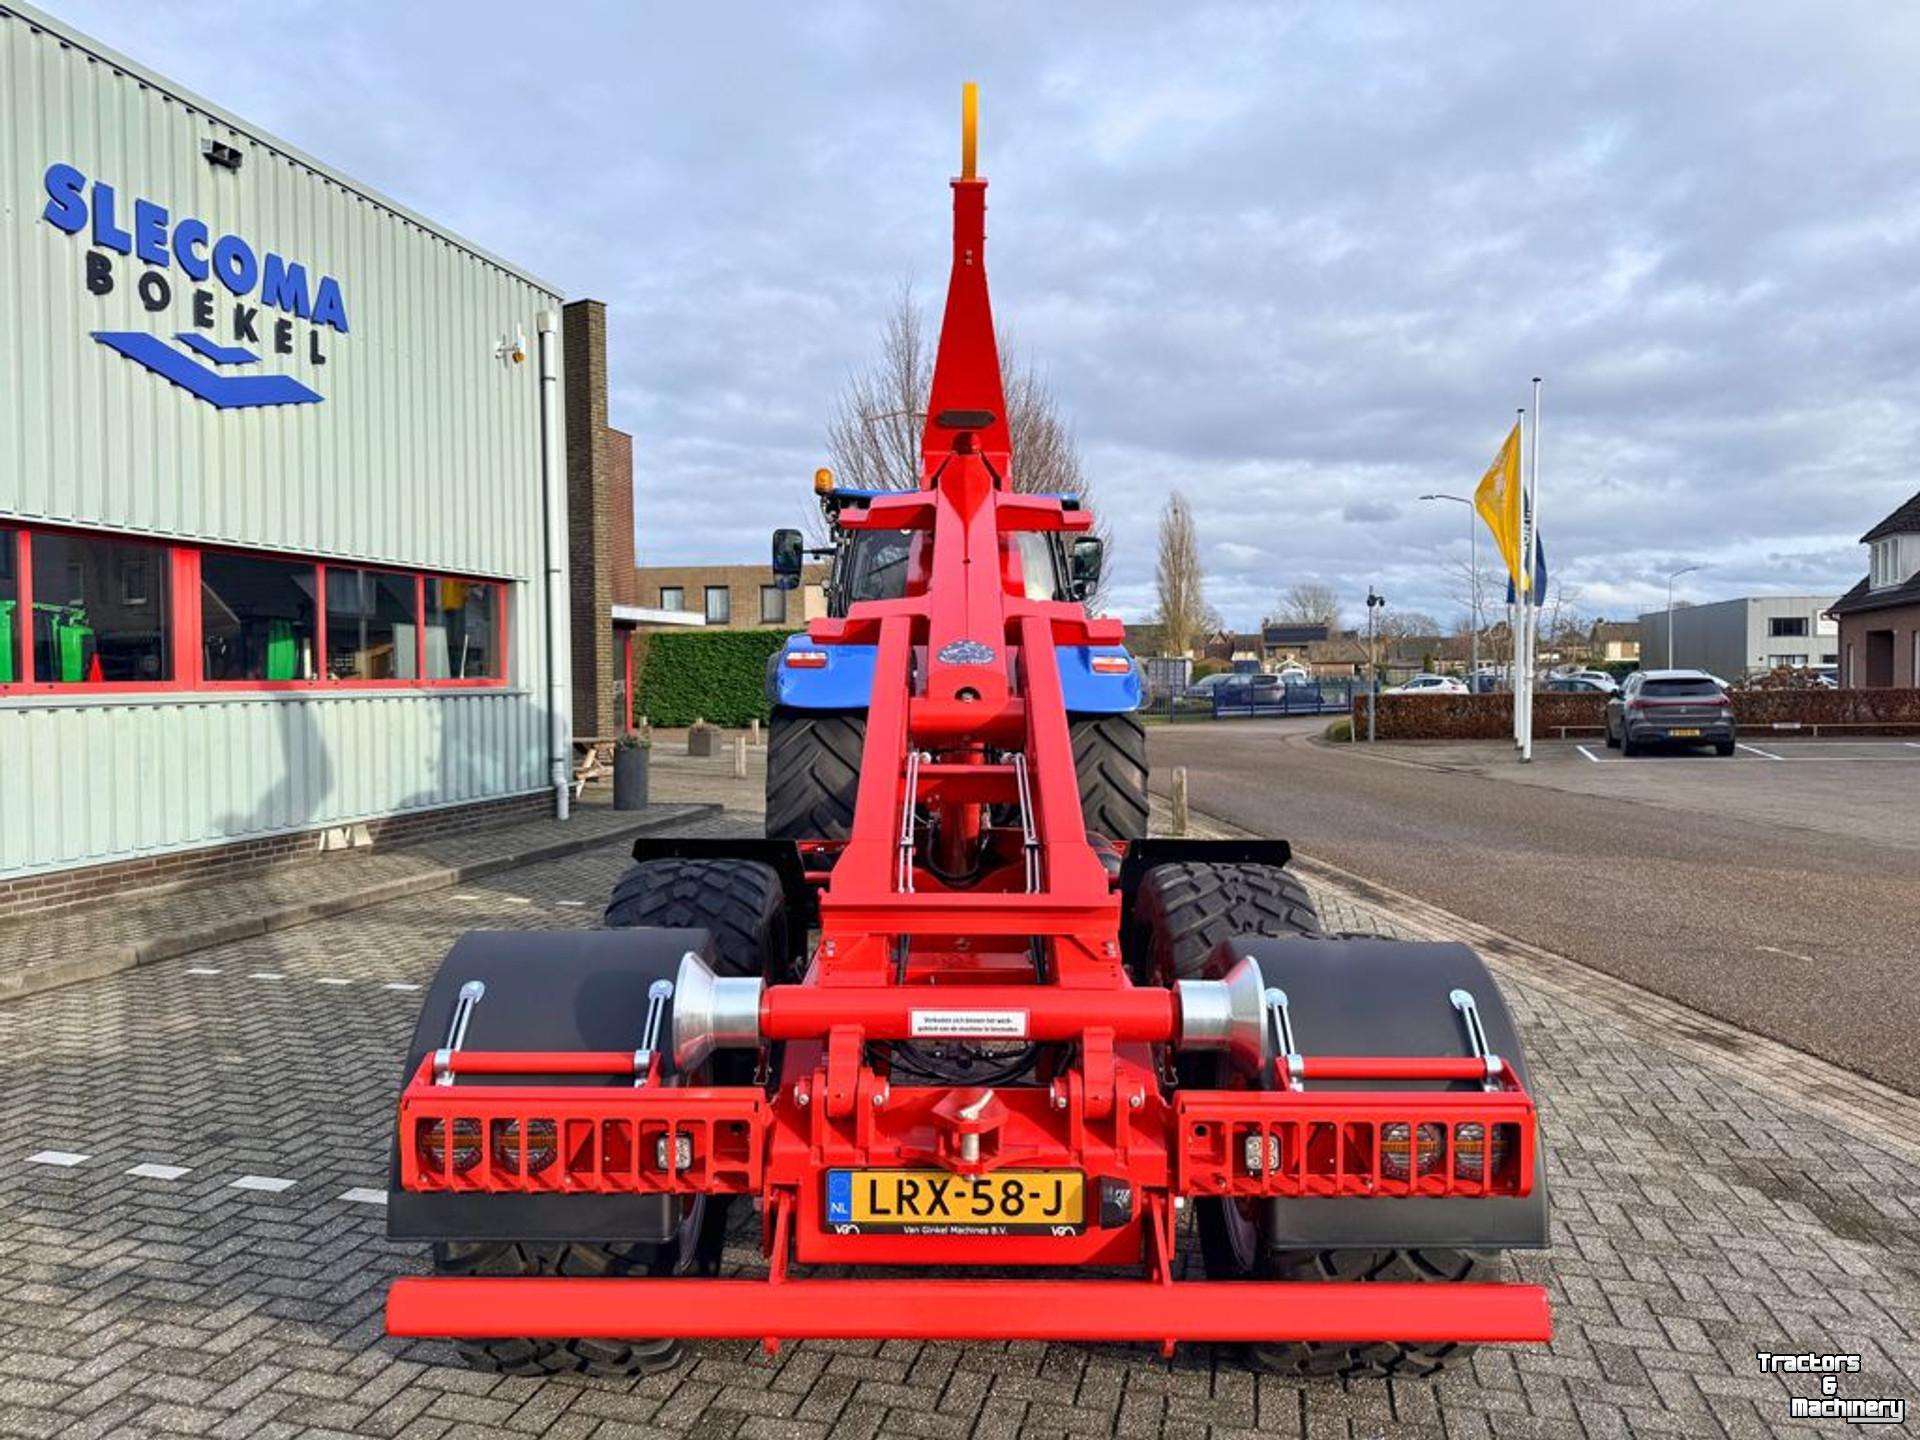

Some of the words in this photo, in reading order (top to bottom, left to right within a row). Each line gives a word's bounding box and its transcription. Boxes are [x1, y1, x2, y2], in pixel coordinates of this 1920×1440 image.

[43, 163, 349, 333] SLECOMA
[86, 250, 326, 364] BOEKEL
[831, 1202, 848, 1214] NL
[870, 1179, 1062, 1216] LRX-58-J
[903, 1226, 919, 1234] Van
[921, 1226, 948, 1234] Ginkel
[950, 1226, 989, 1235] Machines
[990, 1226, 1008, 1235] B.V.
